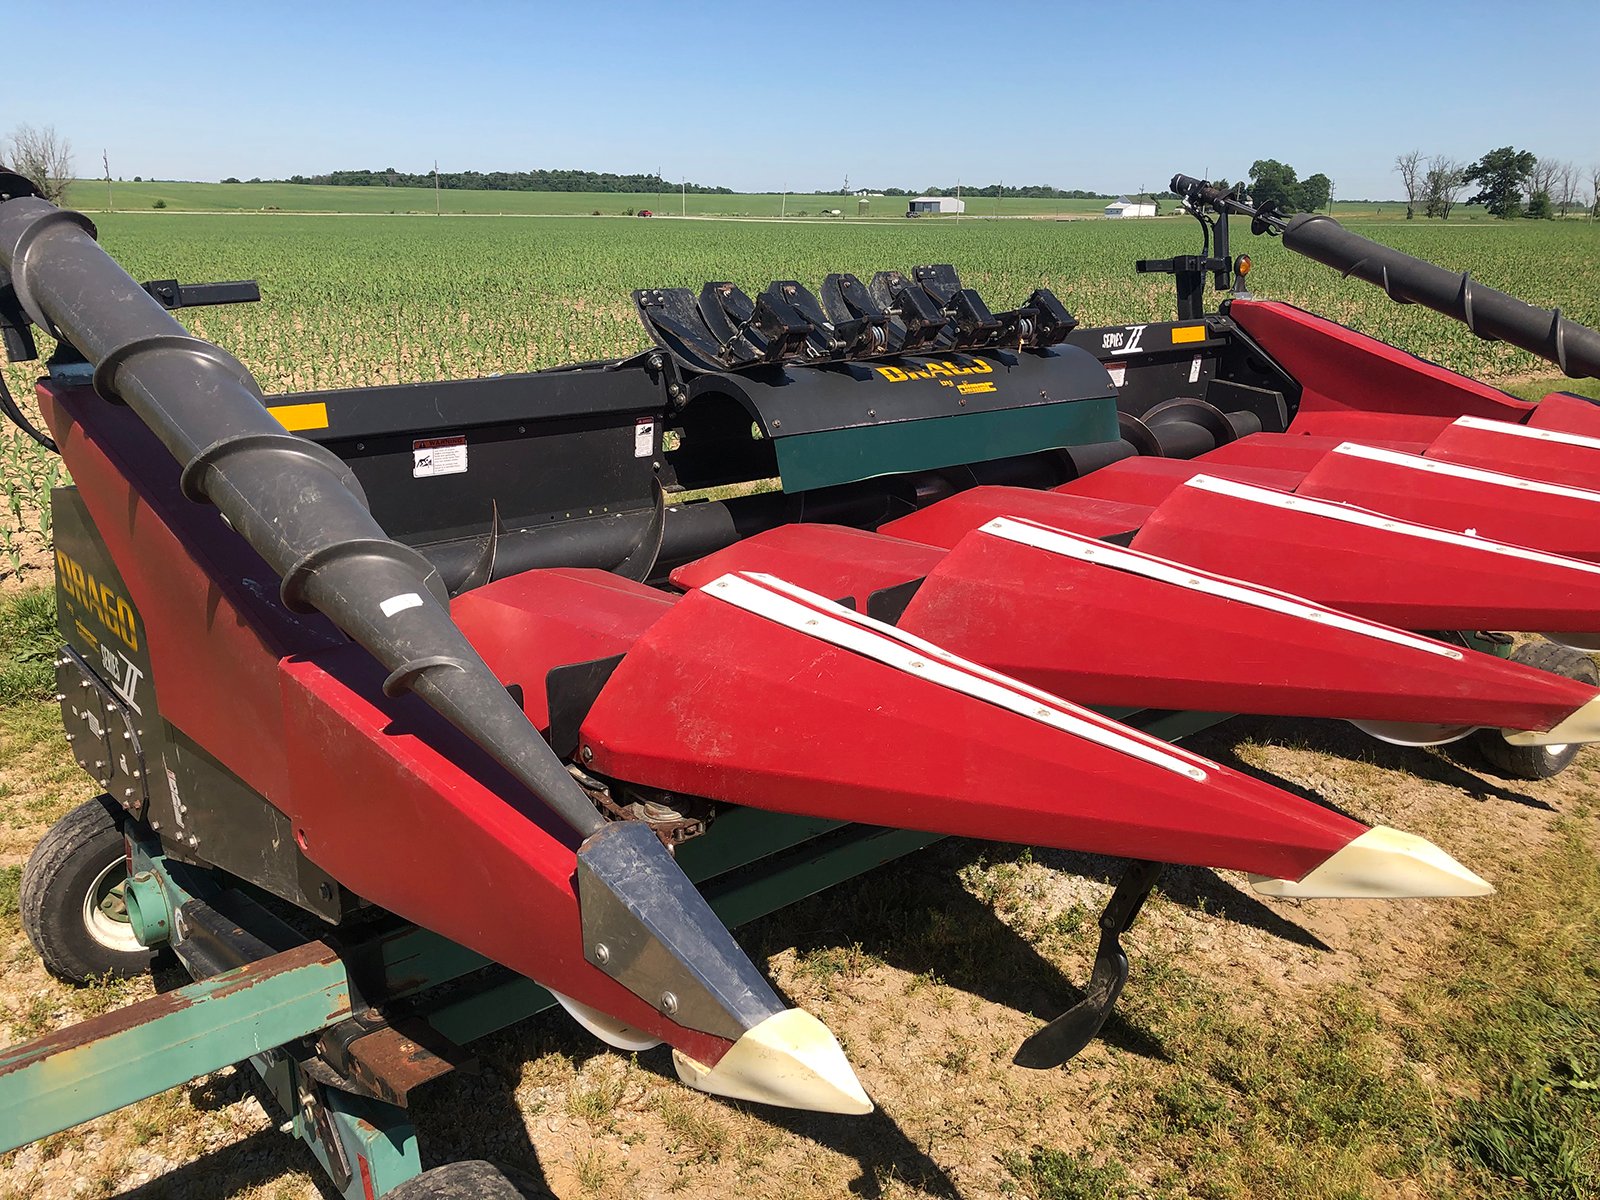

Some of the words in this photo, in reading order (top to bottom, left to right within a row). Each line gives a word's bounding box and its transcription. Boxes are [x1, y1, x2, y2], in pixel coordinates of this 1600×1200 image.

[1102, 332, 1124, 349] SERIES
[56, 548, 139, 652] DRAGO
[100, 643, 120, 682] SERIES
